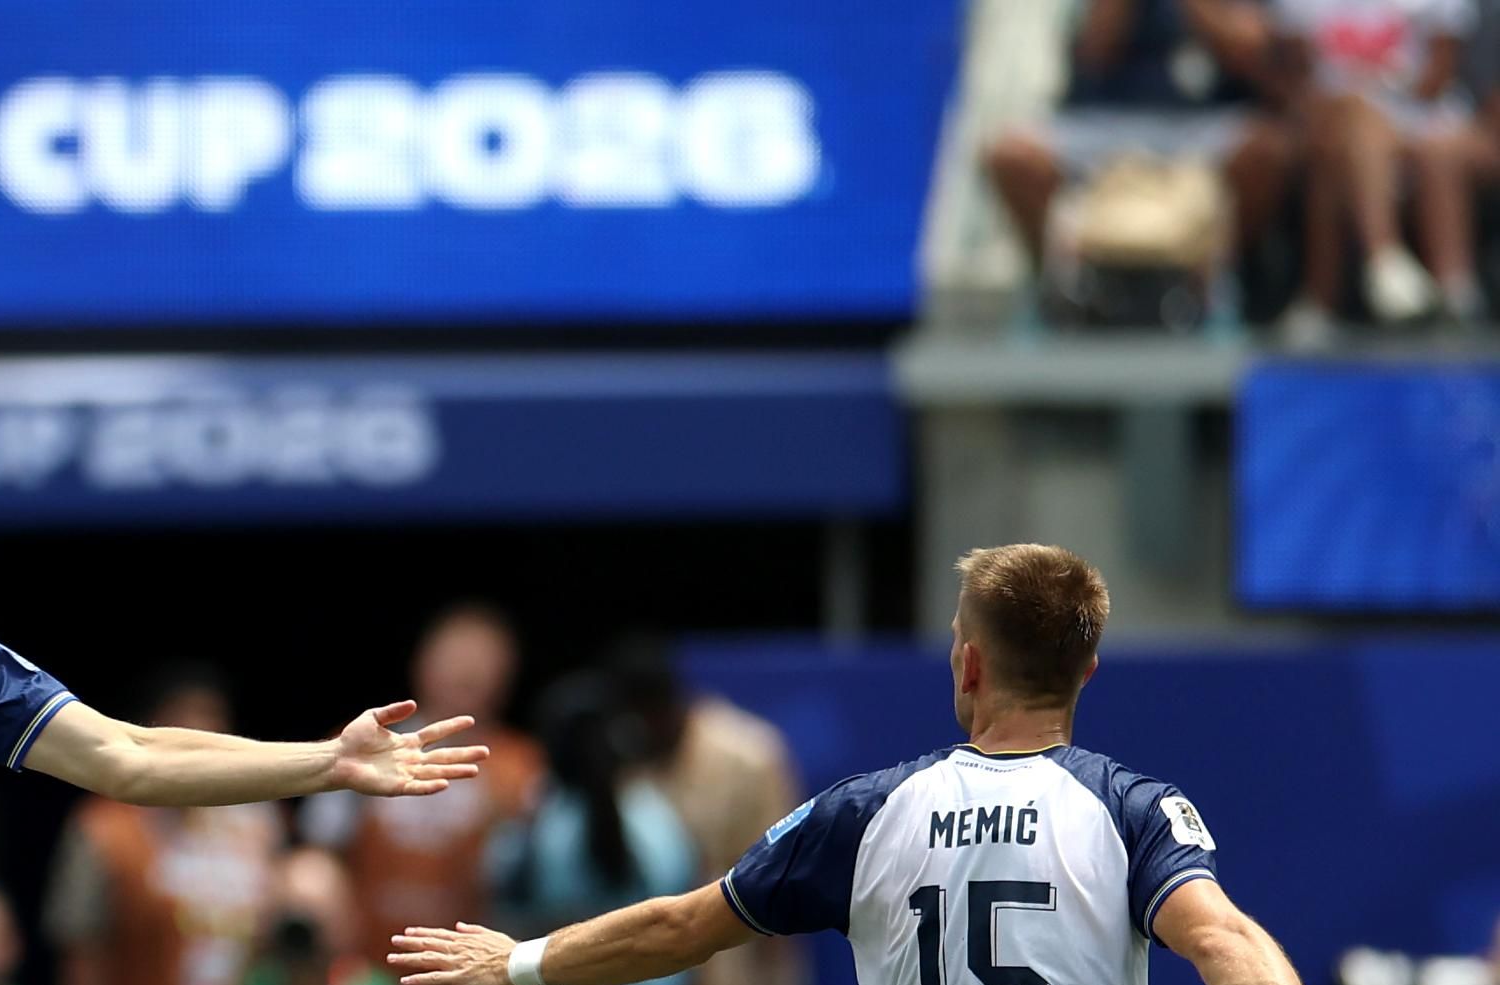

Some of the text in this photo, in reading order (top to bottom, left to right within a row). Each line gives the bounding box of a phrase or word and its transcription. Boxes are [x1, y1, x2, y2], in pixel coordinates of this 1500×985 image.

[295, 70, 822, 210] 2026
[88, 396, 436, 487] 2026
[928, 800, 1039, 849] MEMIĆ
